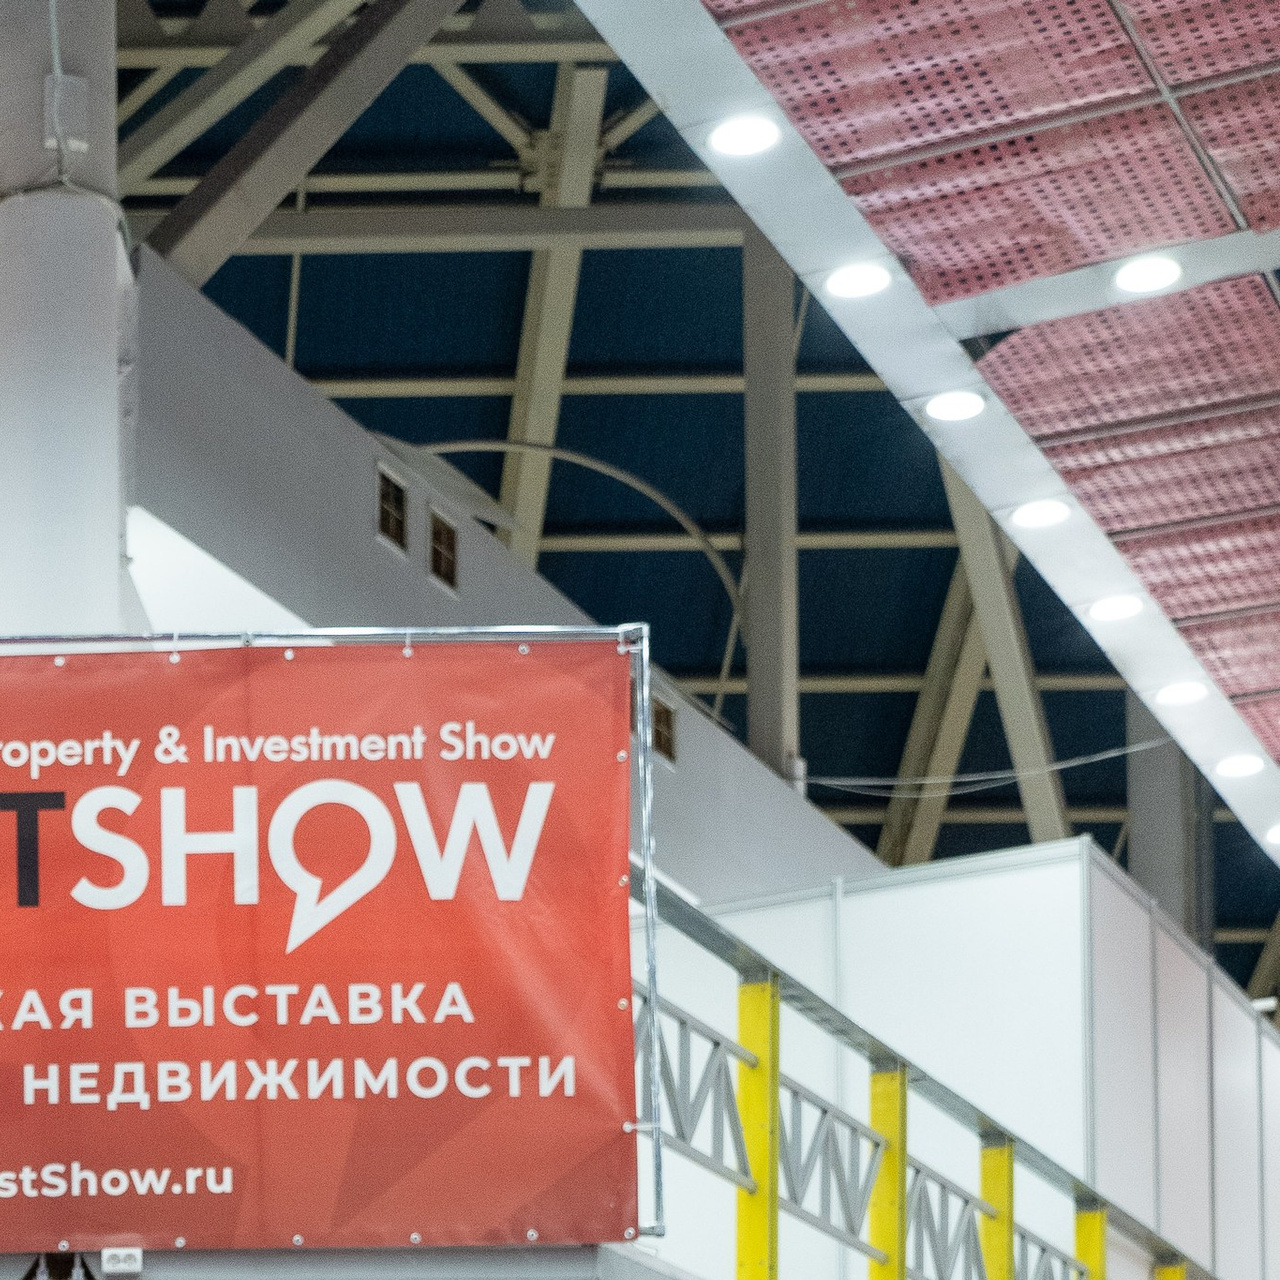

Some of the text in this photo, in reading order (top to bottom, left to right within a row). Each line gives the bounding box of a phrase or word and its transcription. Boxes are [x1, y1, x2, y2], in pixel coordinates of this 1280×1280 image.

[154, 728, 190, 764] &
[203, 723, 426, 763] Investment
[440, 721, 555, 760] Show
[124, 981, 474, 1029] ВЫСТАВКА
[24, 1056, 576, 1112] НЕДВИЖИМОСТИ
